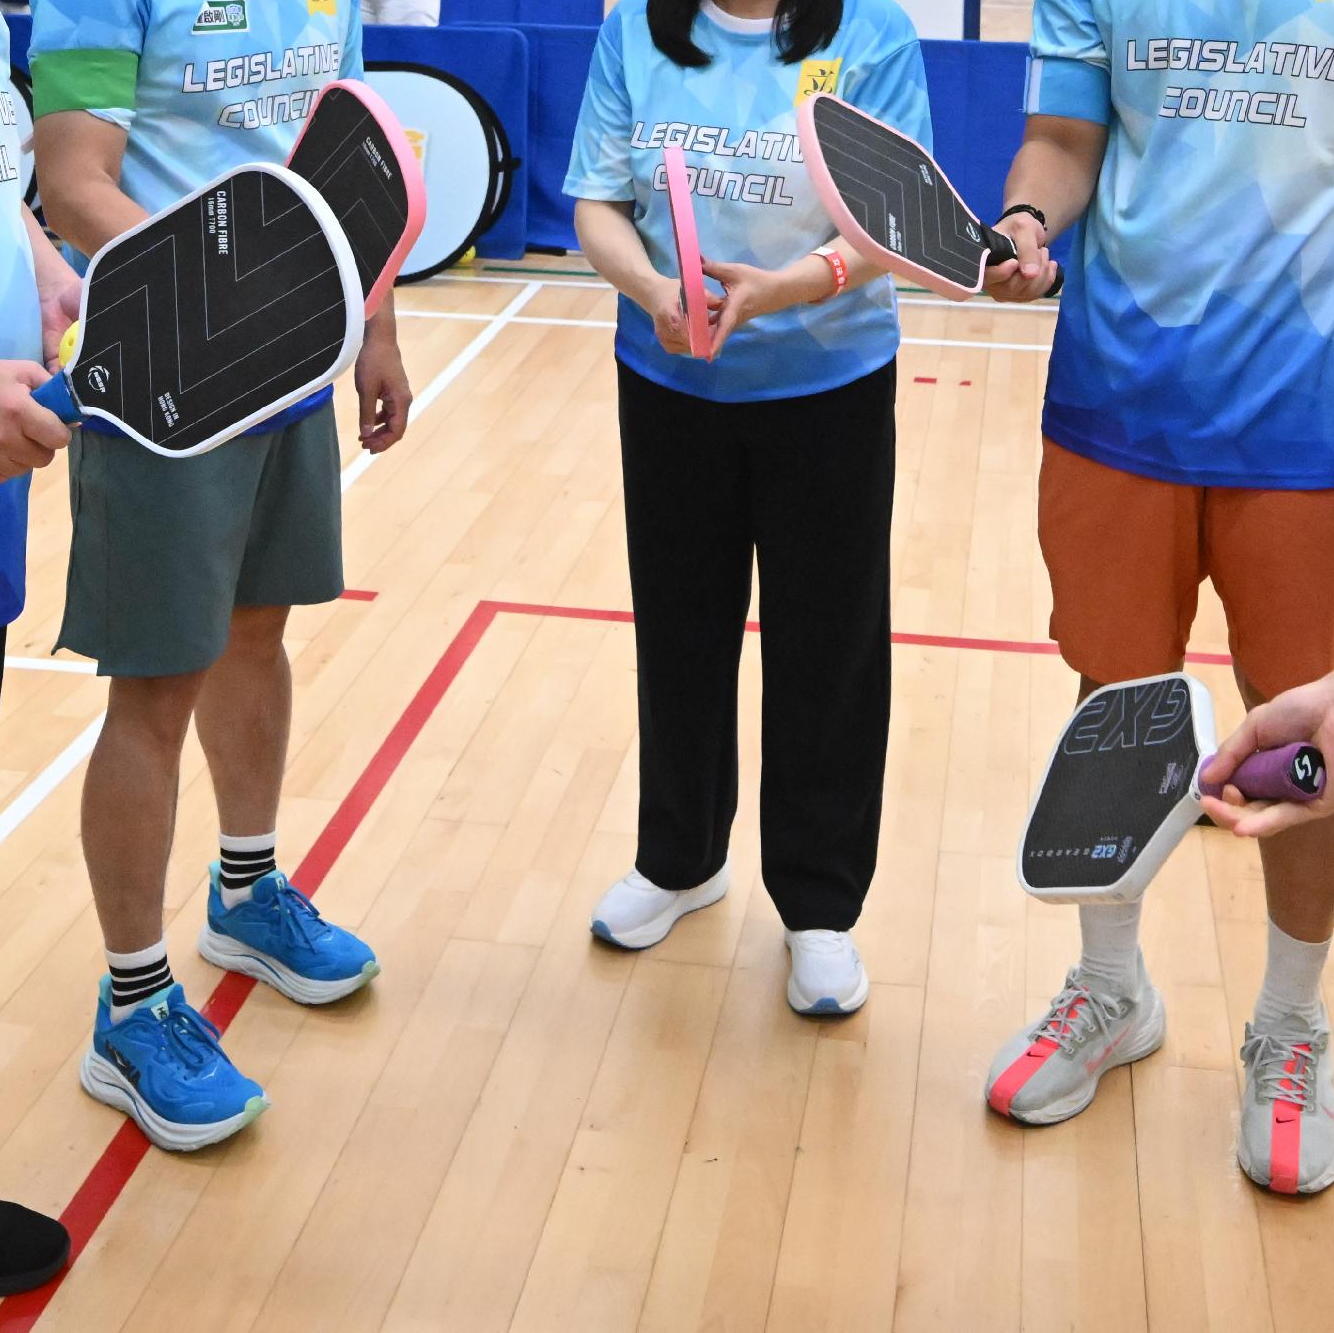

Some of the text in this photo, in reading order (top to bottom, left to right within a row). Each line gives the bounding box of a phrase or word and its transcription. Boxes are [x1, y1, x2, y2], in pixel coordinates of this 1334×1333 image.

[182, 42, 339, 94] LEGISLATIVE
[1159, 88, 1307, 129] COUNCIL
[630, 121, 804, 163] LEGISLATIV
[208, 217, 216, 234] T700
[216, 190, 229, 255] CARBON FIBRE
